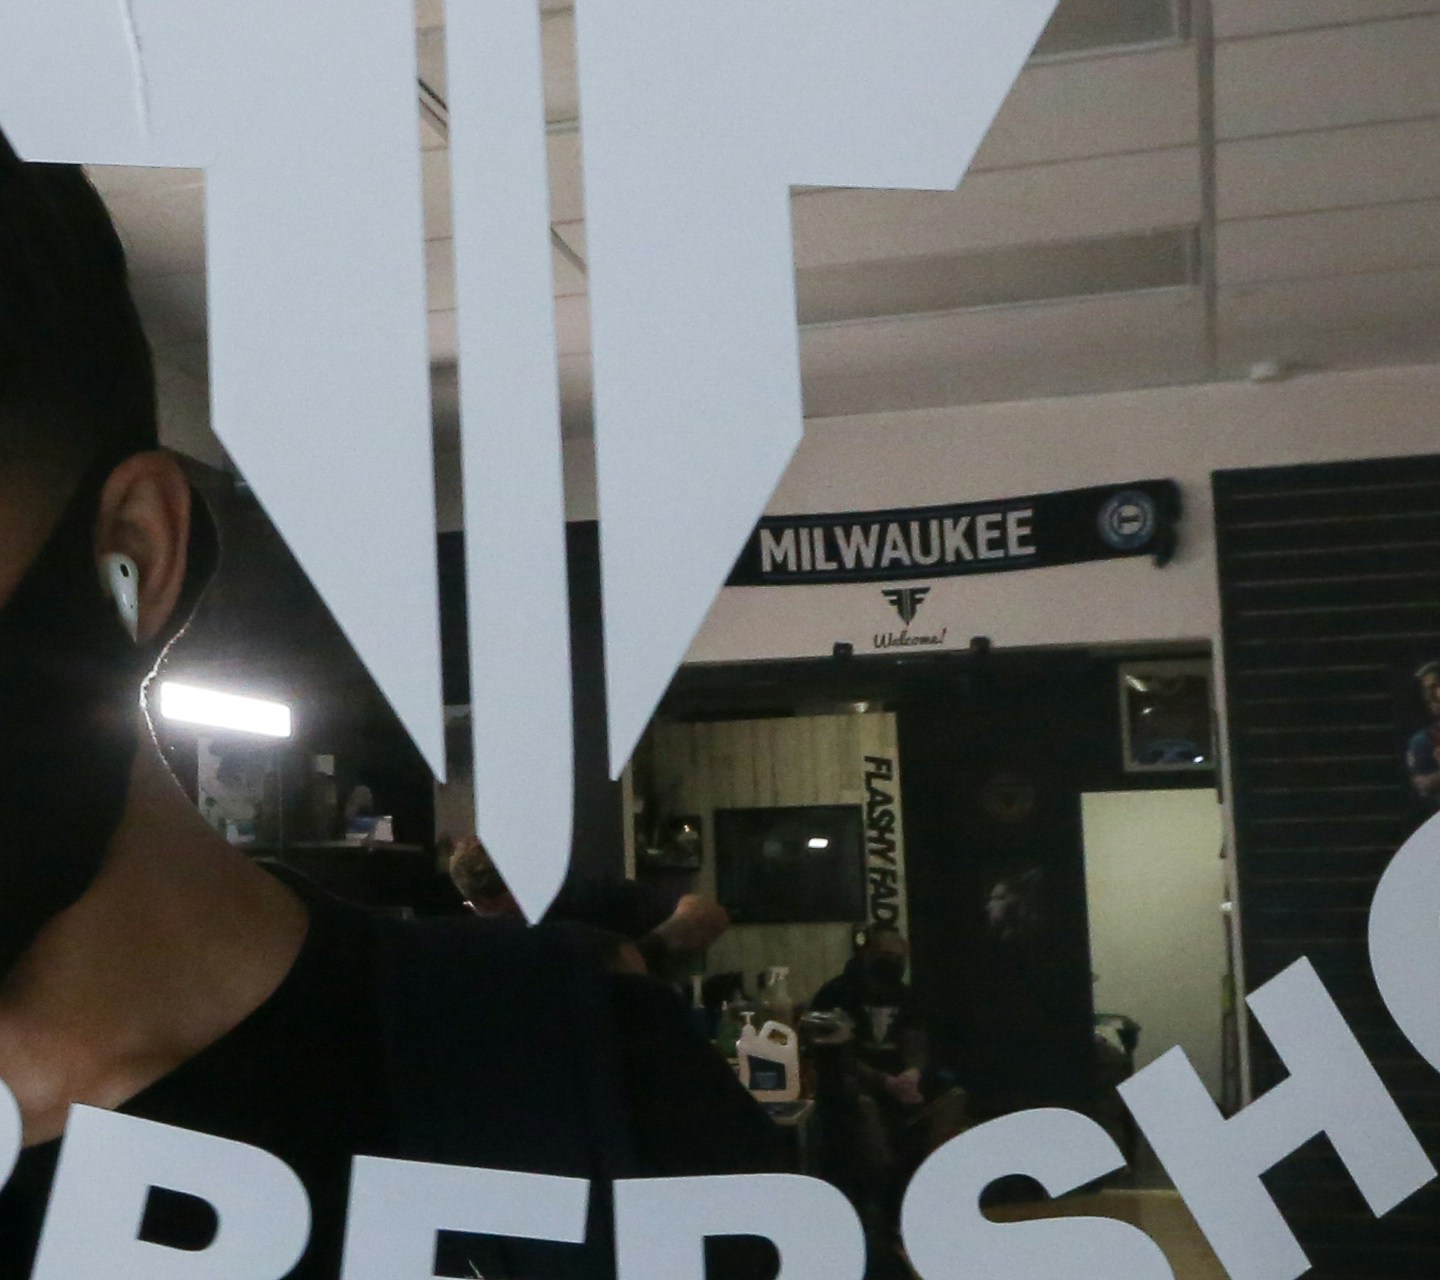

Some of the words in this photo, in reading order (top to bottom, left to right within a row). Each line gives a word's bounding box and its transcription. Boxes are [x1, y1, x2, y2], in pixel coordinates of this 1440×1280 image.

[758, 507, 1037, 574] MILWAUKEE
[873, 626, 948, 649] Welcome!
[863, 755, 896, 866] FLASHY
